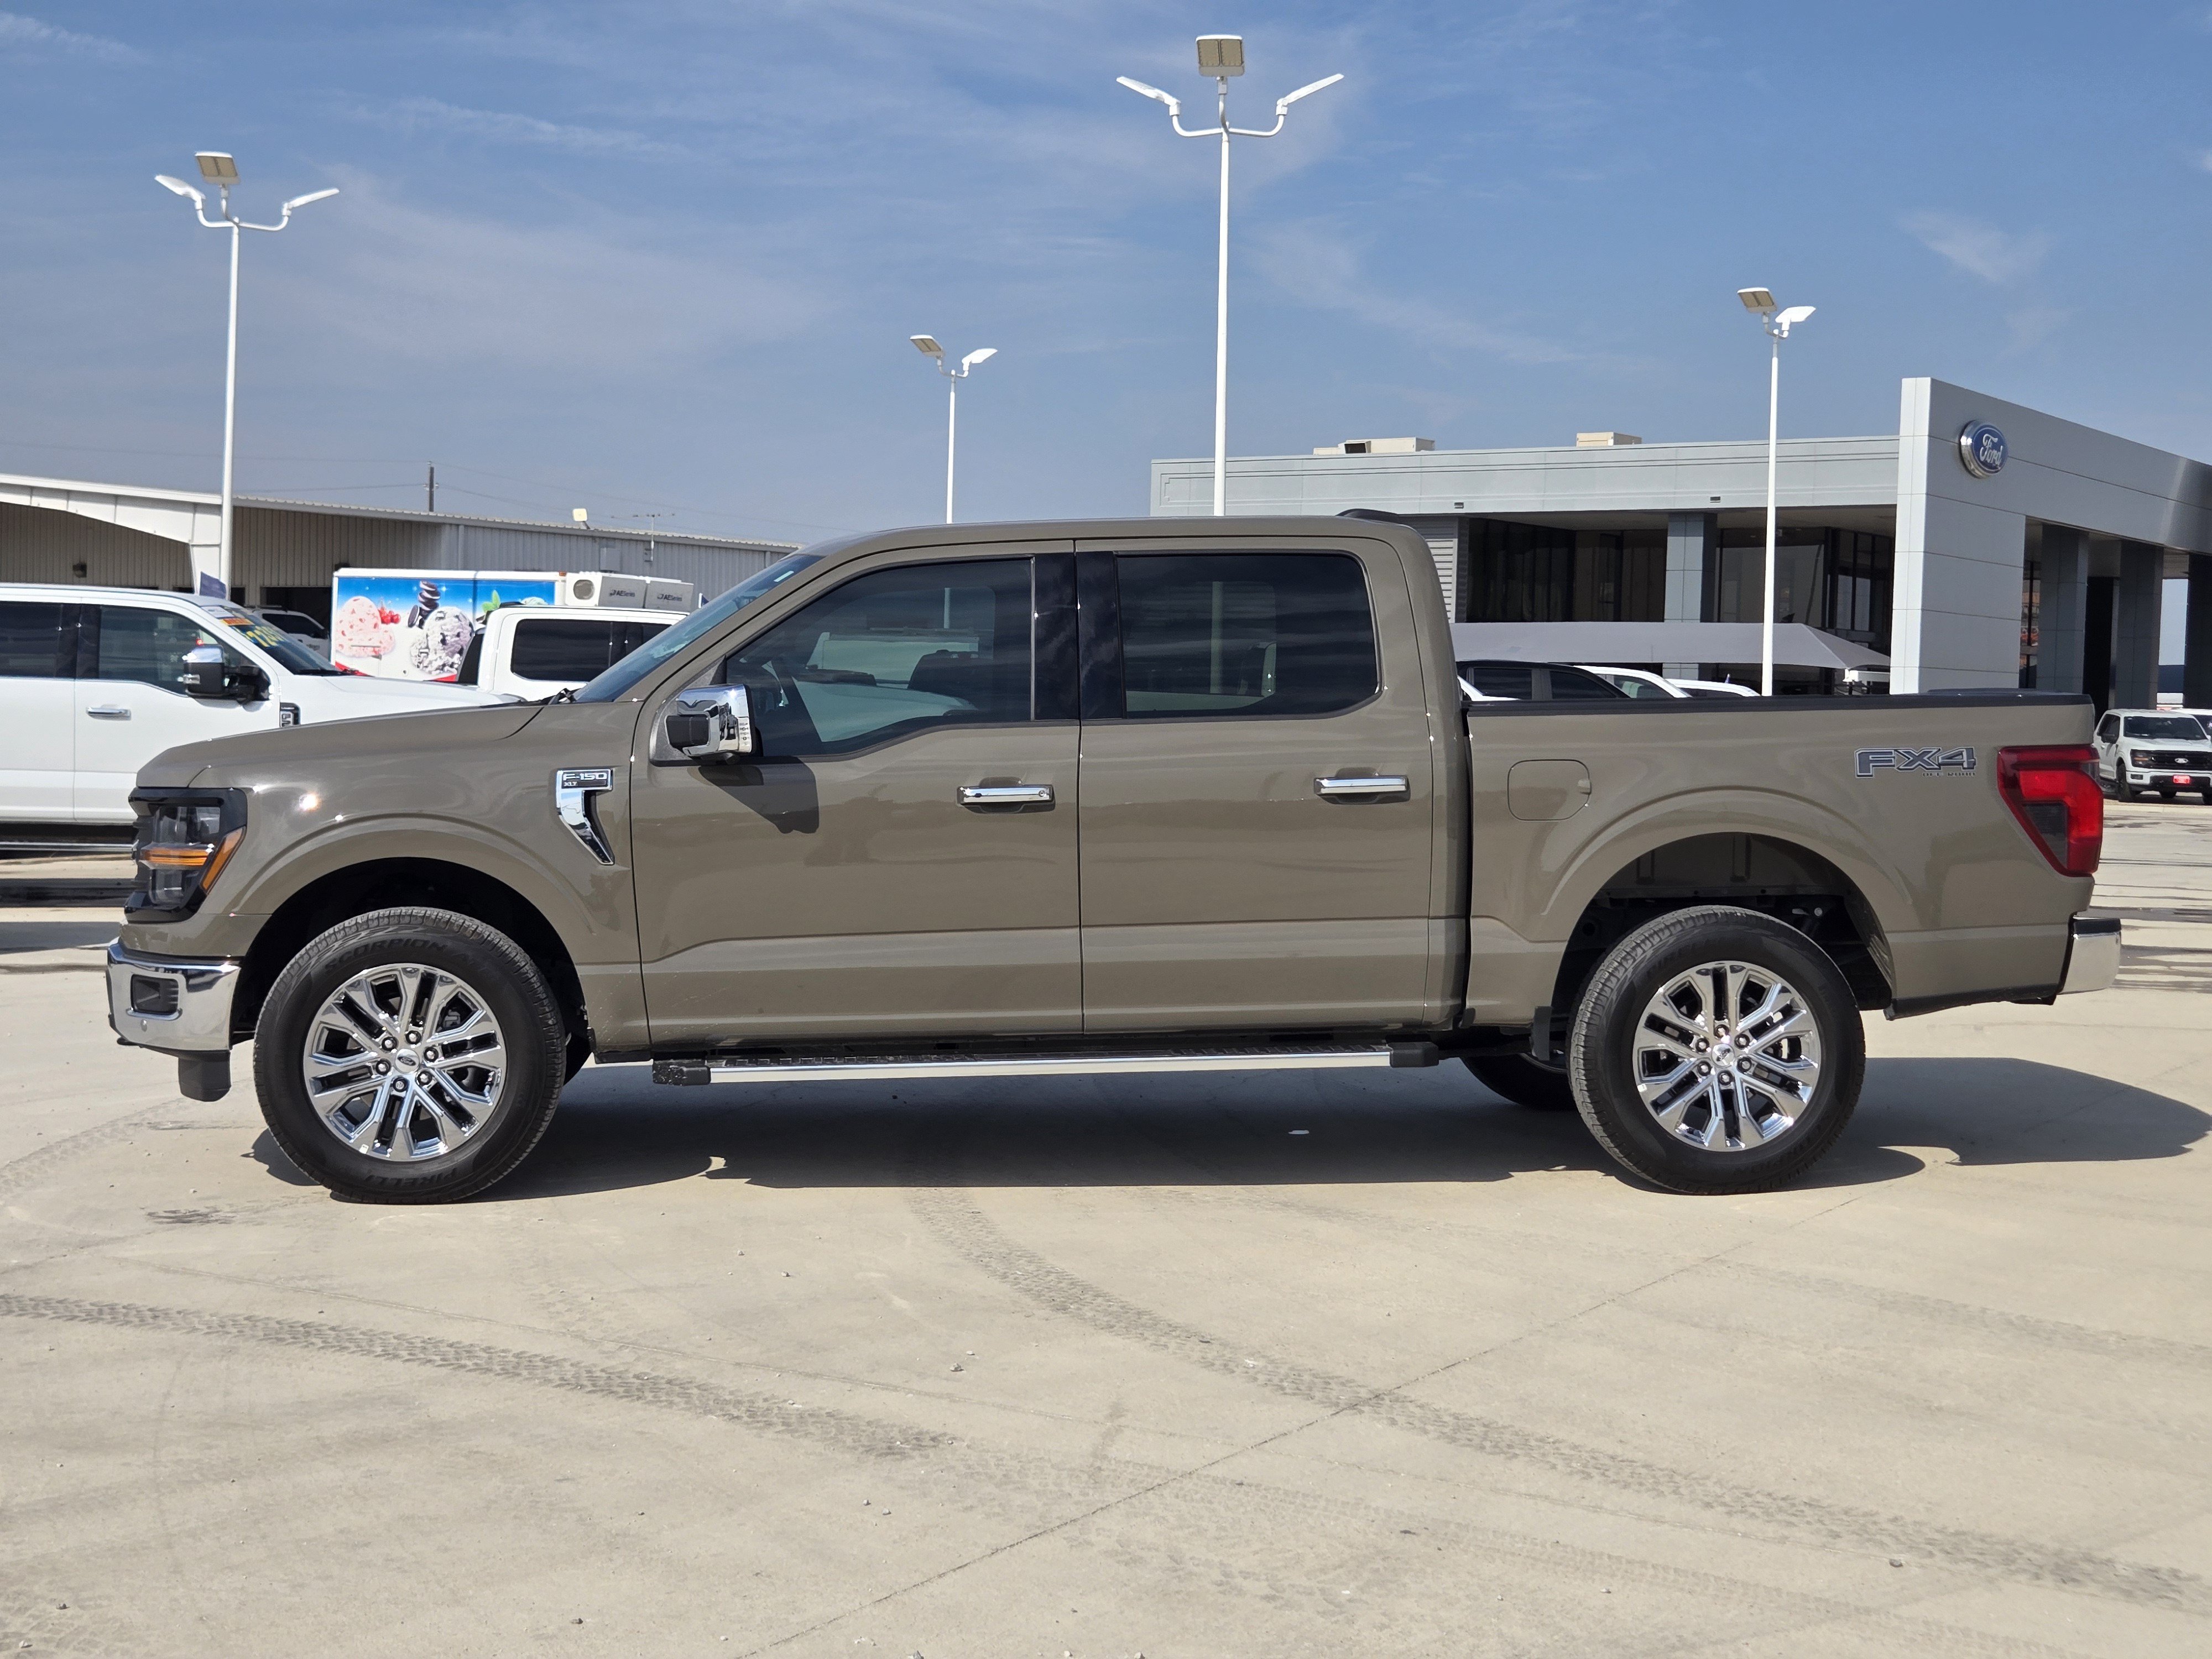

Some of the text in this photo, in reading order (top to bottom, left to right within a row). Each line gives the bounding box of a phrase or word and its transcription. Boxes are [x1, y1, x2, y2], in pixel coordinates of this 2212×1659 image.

[1979, 433, 2004, 466] Ford
[563, 772, 607, 781] F-150
[1855, 747, 1976, 778] FX4
[324, 937, 447, 975] SCORPION
